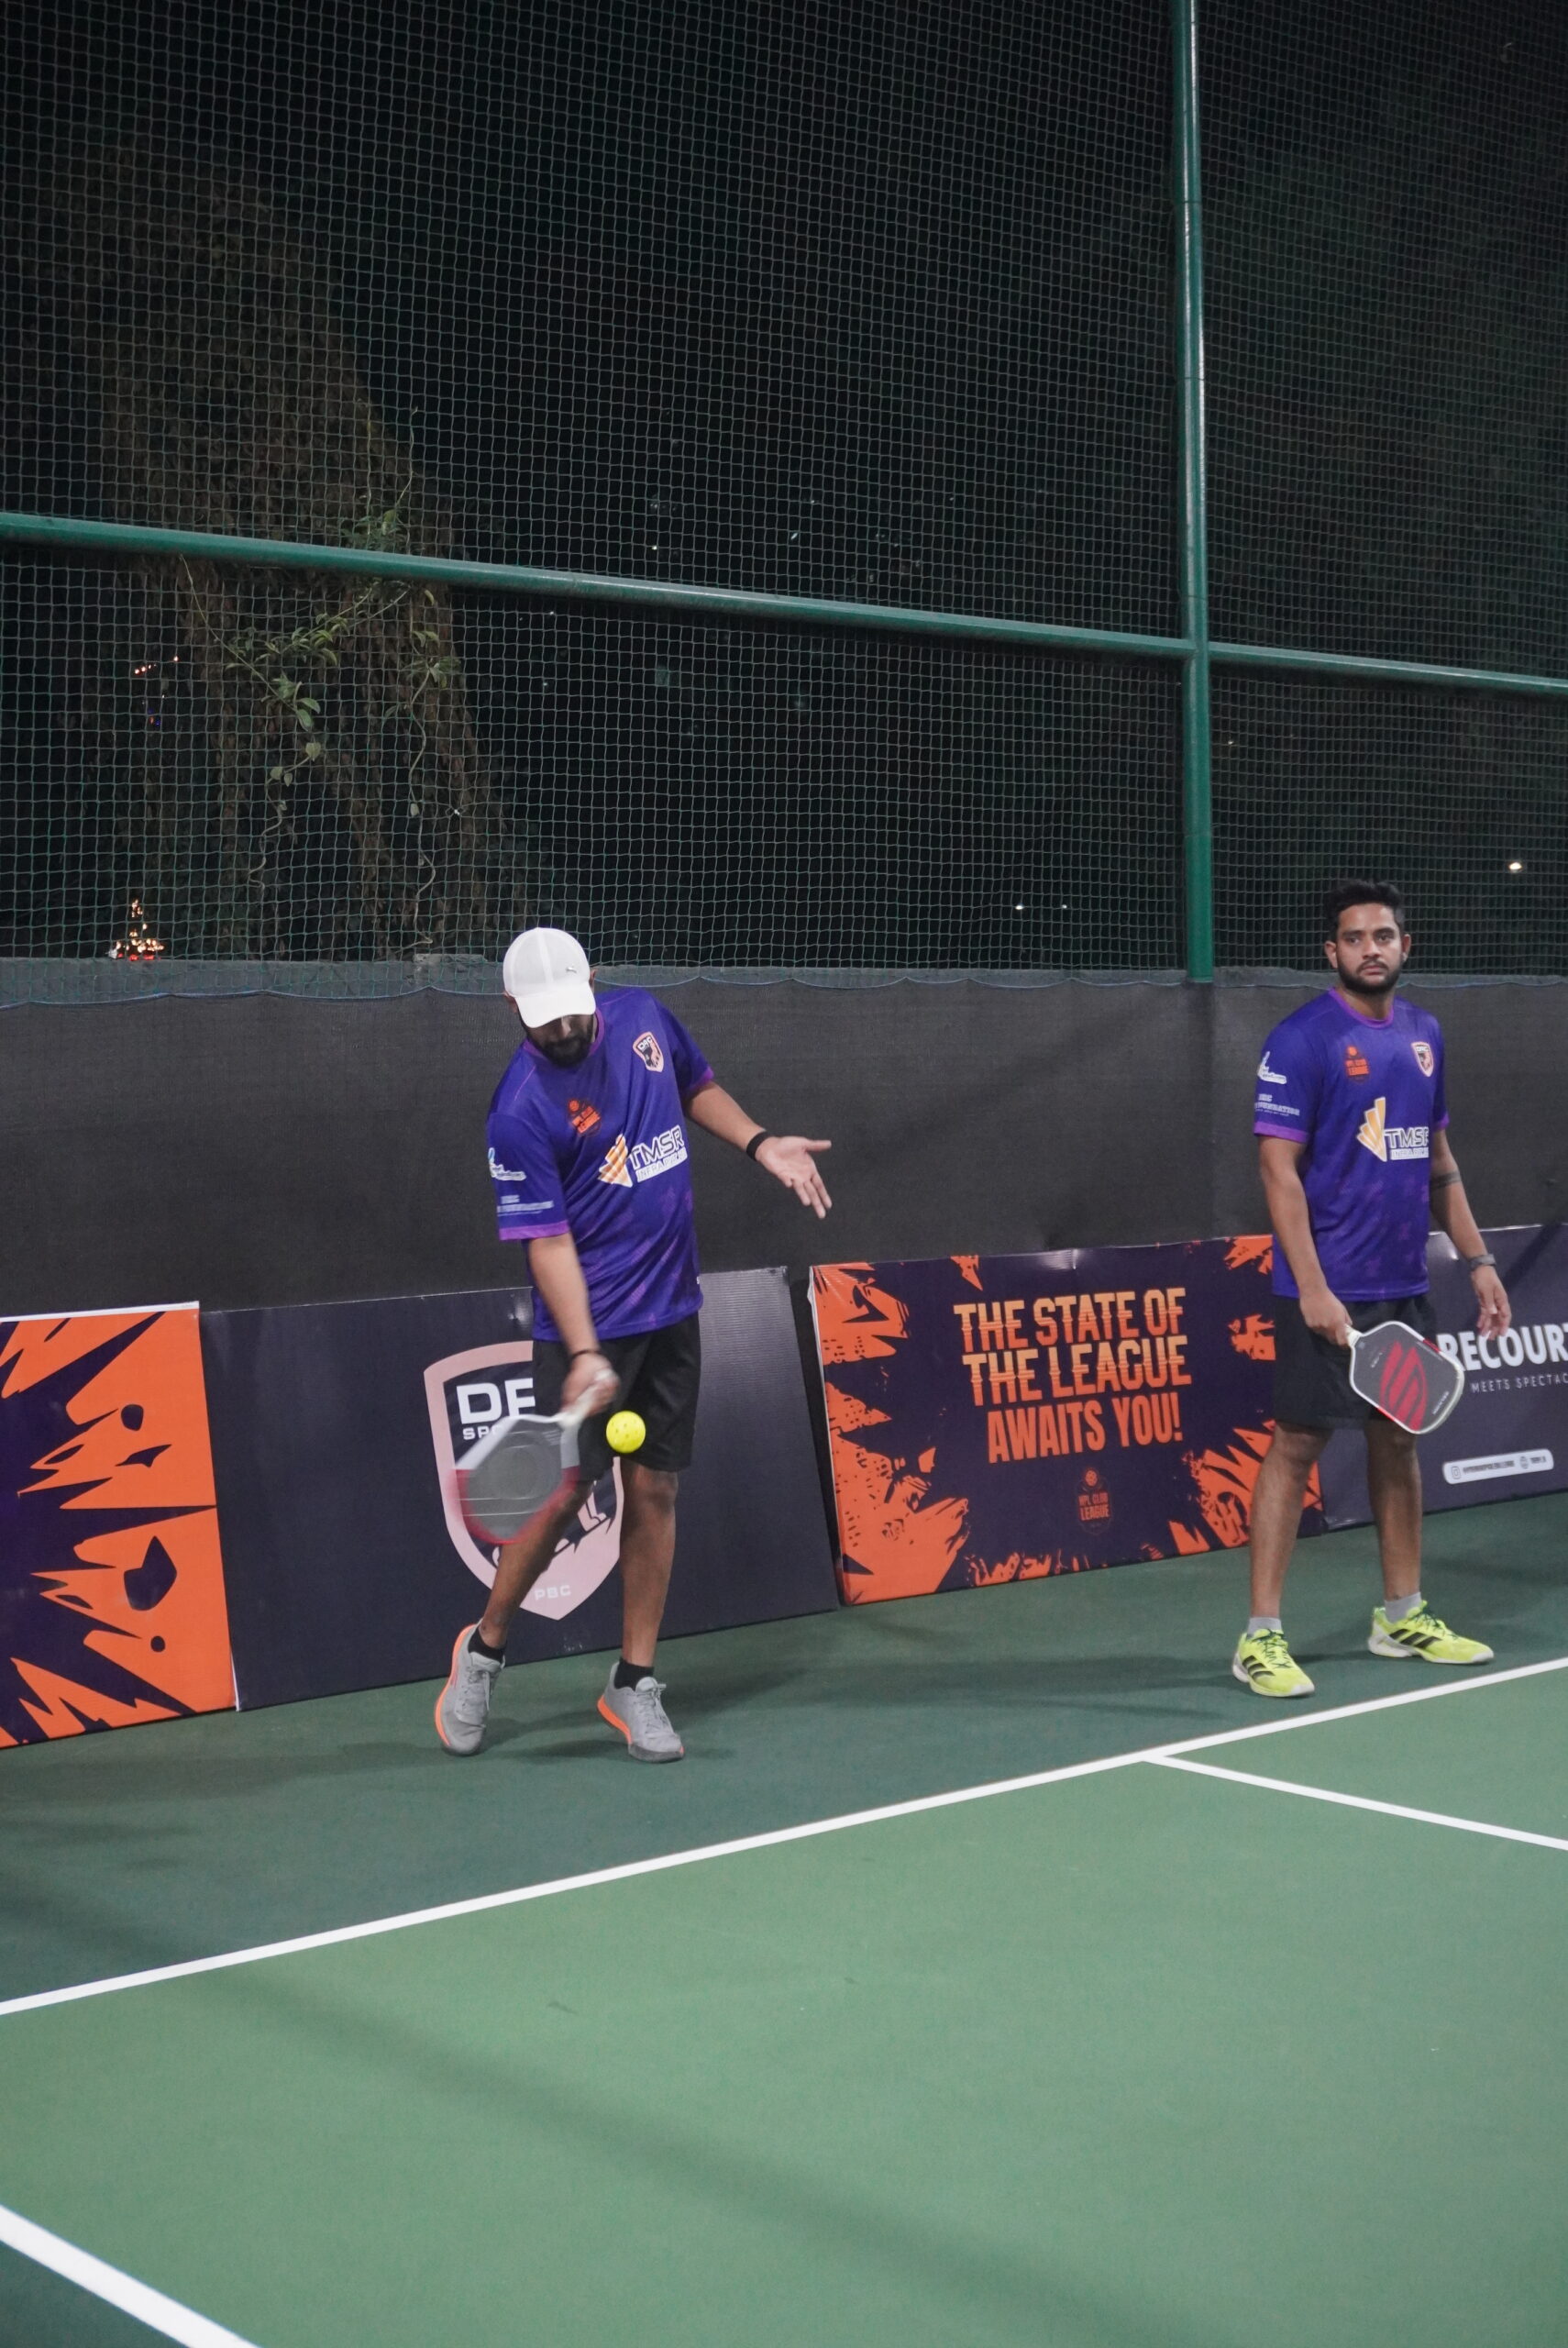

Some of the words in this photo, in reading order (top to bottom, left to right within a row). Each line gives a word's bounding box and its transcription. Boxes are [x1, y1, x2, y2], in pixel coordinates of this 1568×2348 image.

[629, 1124, 685, 1170] TMSR
[954, 1300, 1028, 1353] THE
[1033, 1291, 1139, 1346] STATE
[1143, 1287, 1186, 1335] OF
[962, 1349, 1043, 1406] THE
[1048, 1335, 1192, 1399] LEAGUE
[1436, 1323, 1568, 1371] RECOUR
[1471, 1379, 1510, 1393] MEETS
[988, 1400, 1106, 1464] AWAITS
[1112, 1391, 1183, 1447] YOU!
[1079, 1504, 1110, 1521] LEAGUE
[534, 1585, 571, 1600] PBC
